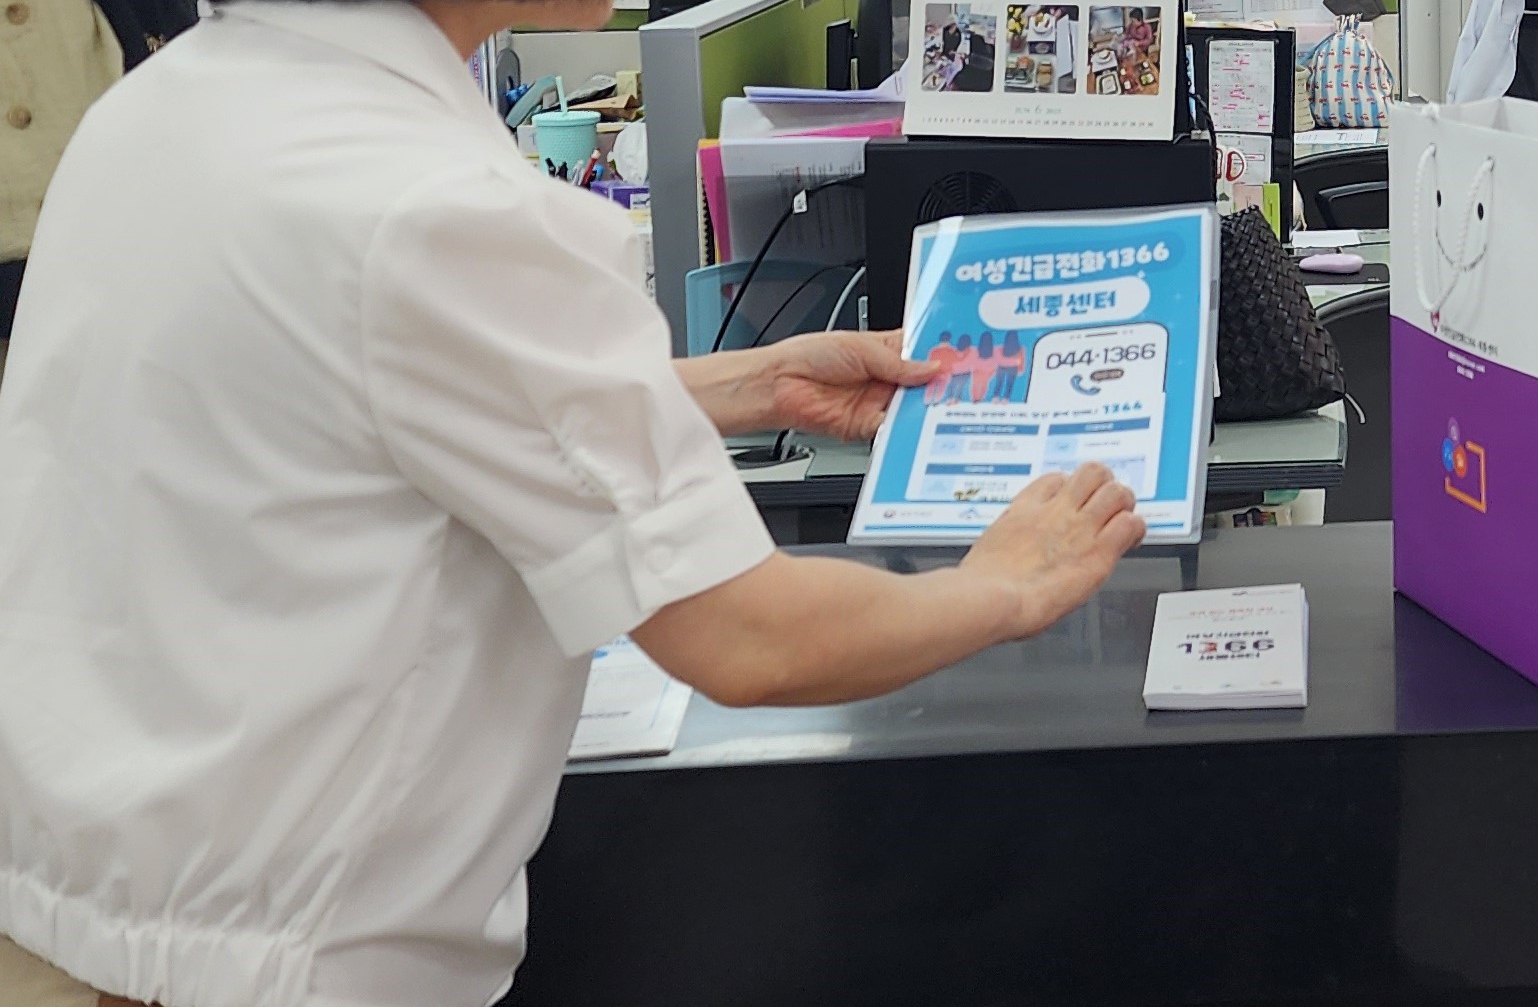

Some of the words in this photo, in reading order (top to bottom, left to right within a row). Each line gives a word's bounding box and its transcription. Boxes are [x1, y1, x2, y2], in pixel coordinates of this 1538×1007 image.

[954, 241, 1170, 285] 여성긴급전화1366
[1013, 290, 1117, 317] 세종센터
[1177, 639, 1275, 655] 1366
